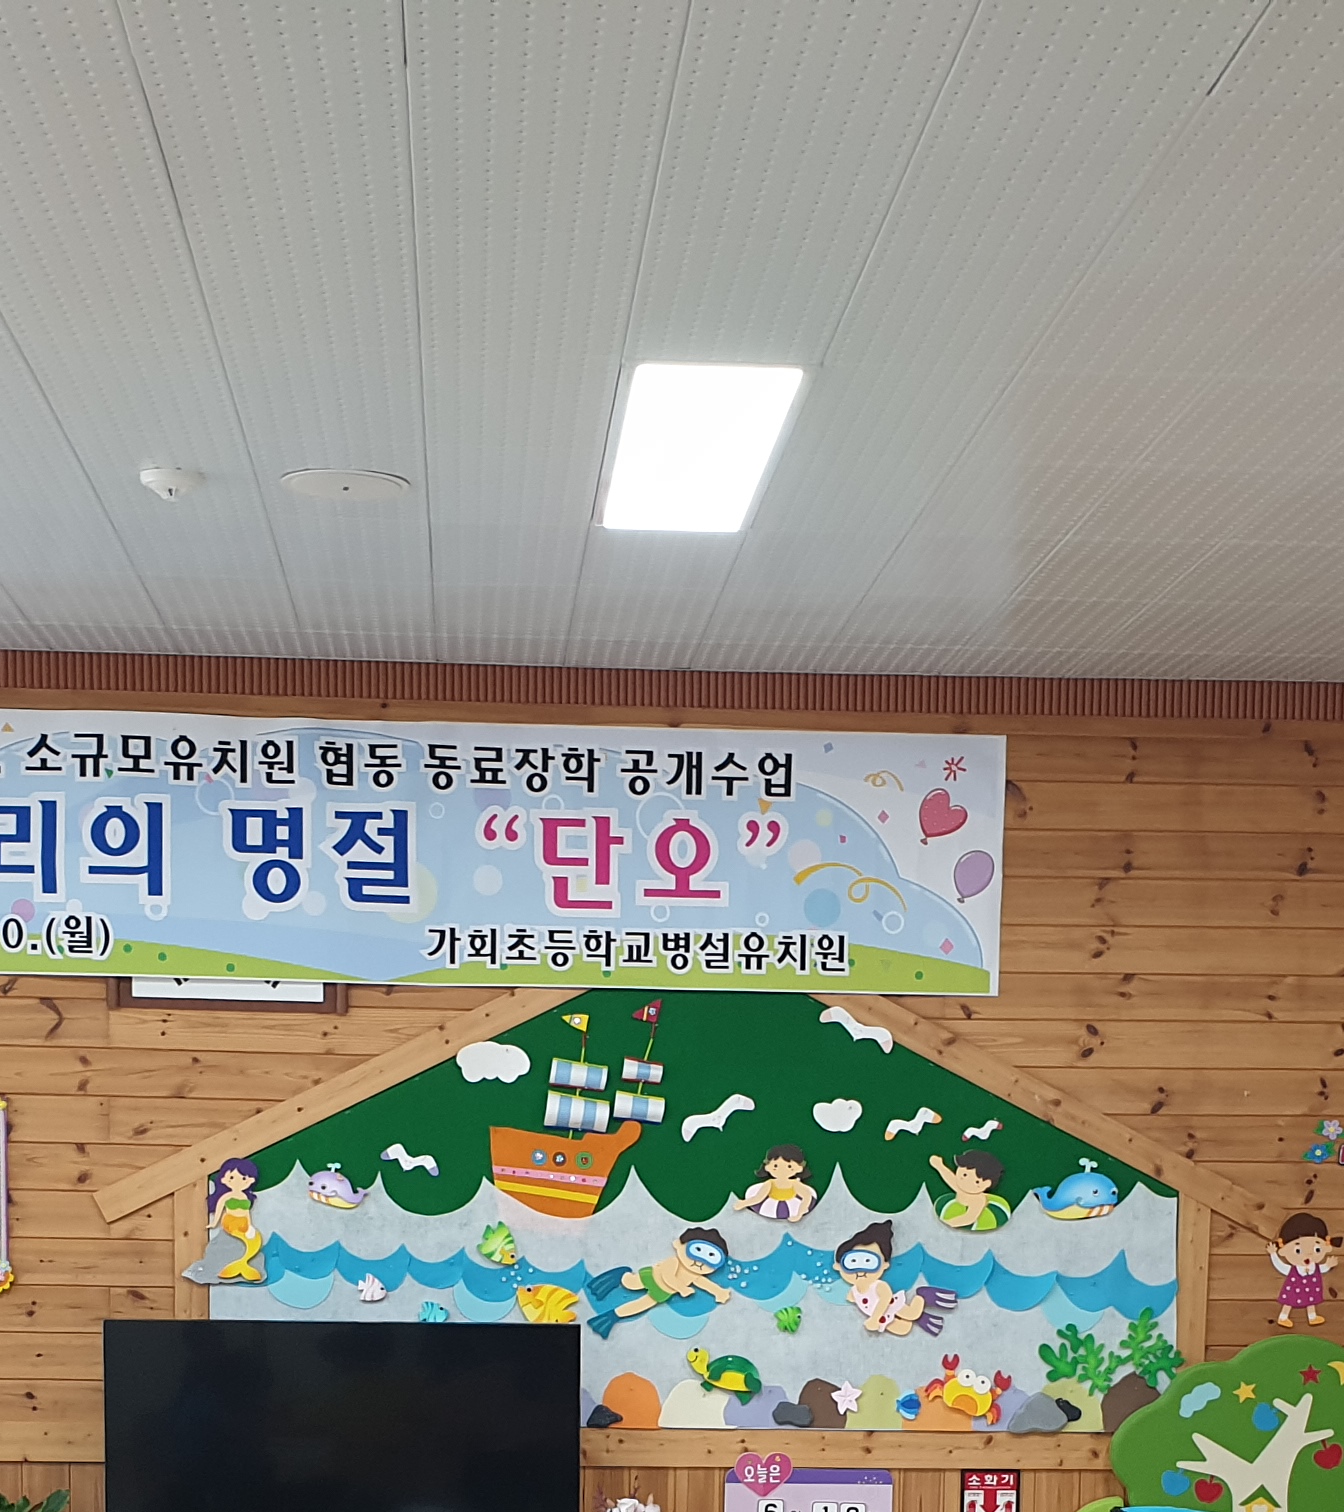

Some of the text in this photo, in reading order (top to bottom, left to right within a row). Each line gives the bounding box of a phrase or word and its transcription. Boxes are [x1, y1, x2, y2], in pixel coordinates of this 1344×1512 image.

[25, 733, 296, 785] 소규모유치원
[318, 740, 403, 788] 협동
[423, 743, 602, 793] 동료장학
[619, 749, 794, 798] 공개수업
[229, 806, 412, 905] 명절
[426, 926, 847, 973] 가회초등학교병설유치원
[743, 1463, 781, 1484] 오늘은
[967, 1474, 1014, 1486] 소화기
